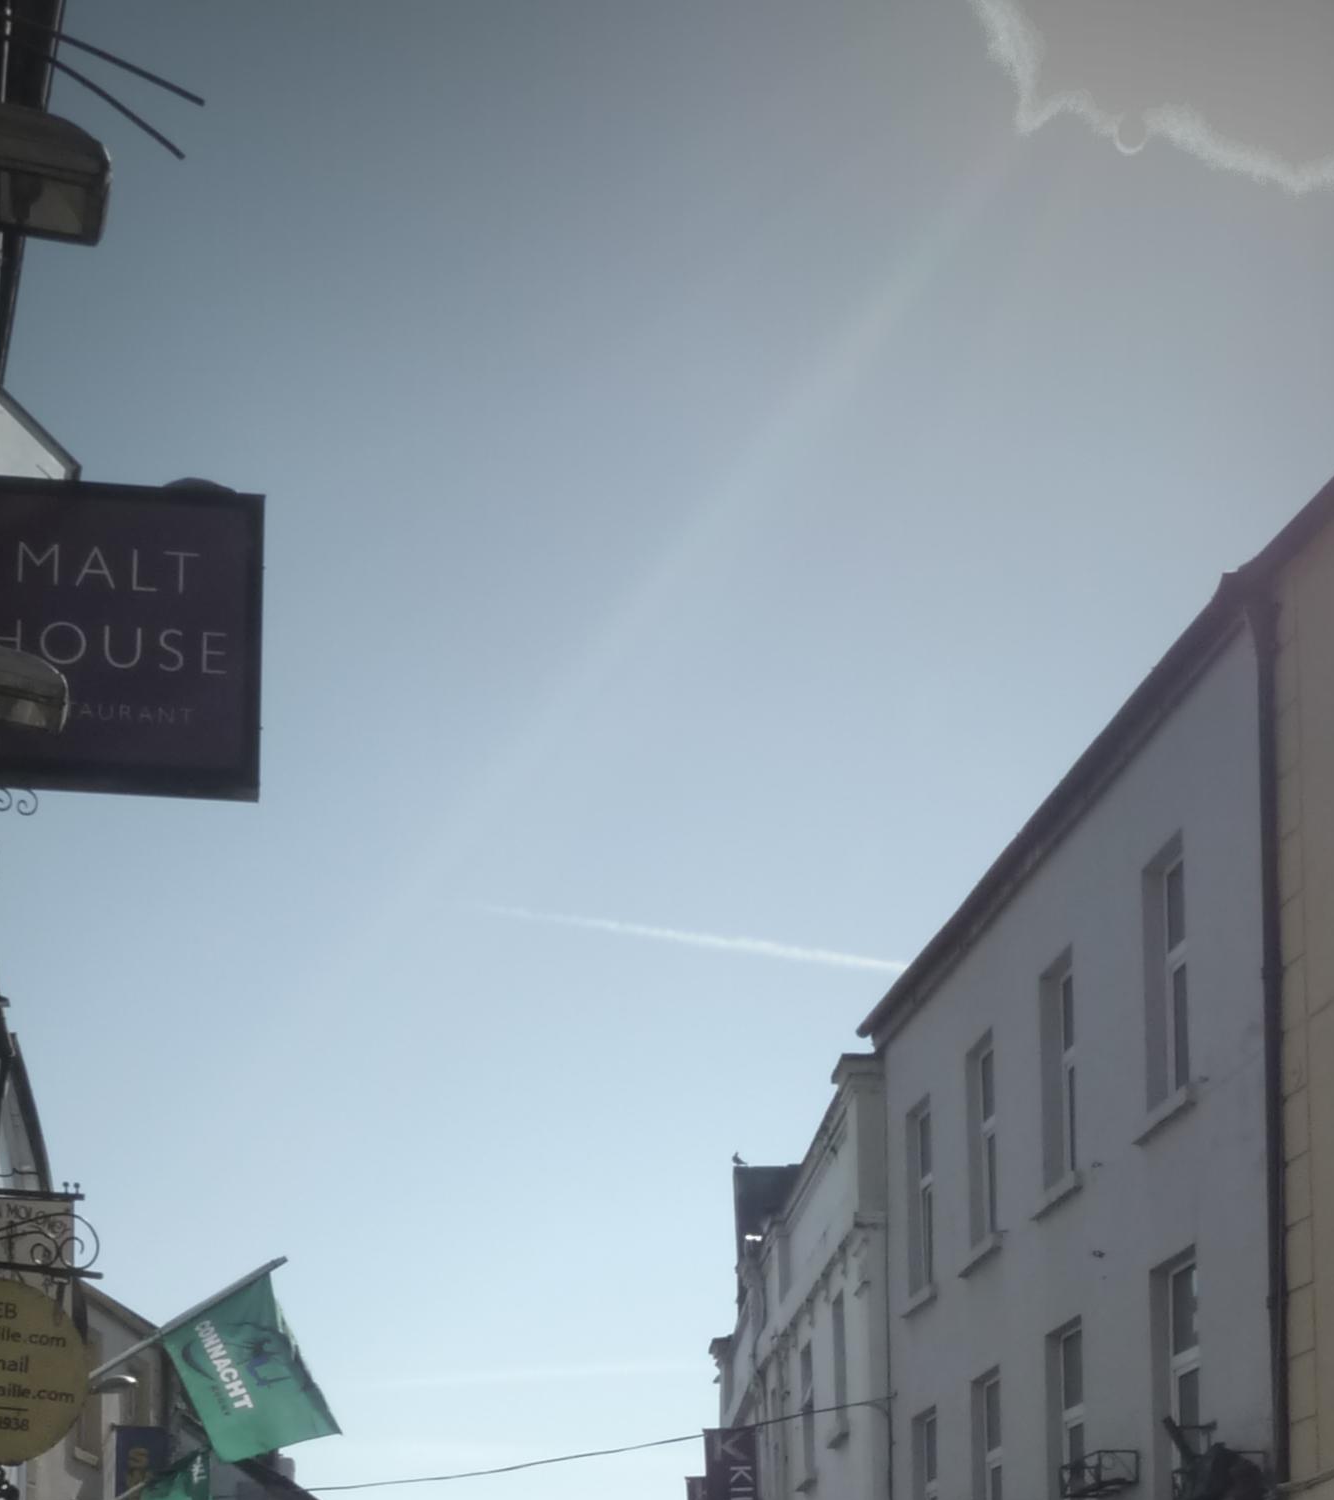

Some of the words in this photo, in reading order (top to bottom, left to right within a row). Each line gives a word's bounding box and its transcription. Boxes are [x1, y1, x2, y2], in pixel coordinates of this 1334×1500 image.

[17, 541, 200, 594] MALT
[67, 701, 195, 727] TAURANT
[194, 1319, 255, 1410] CONNACHT
